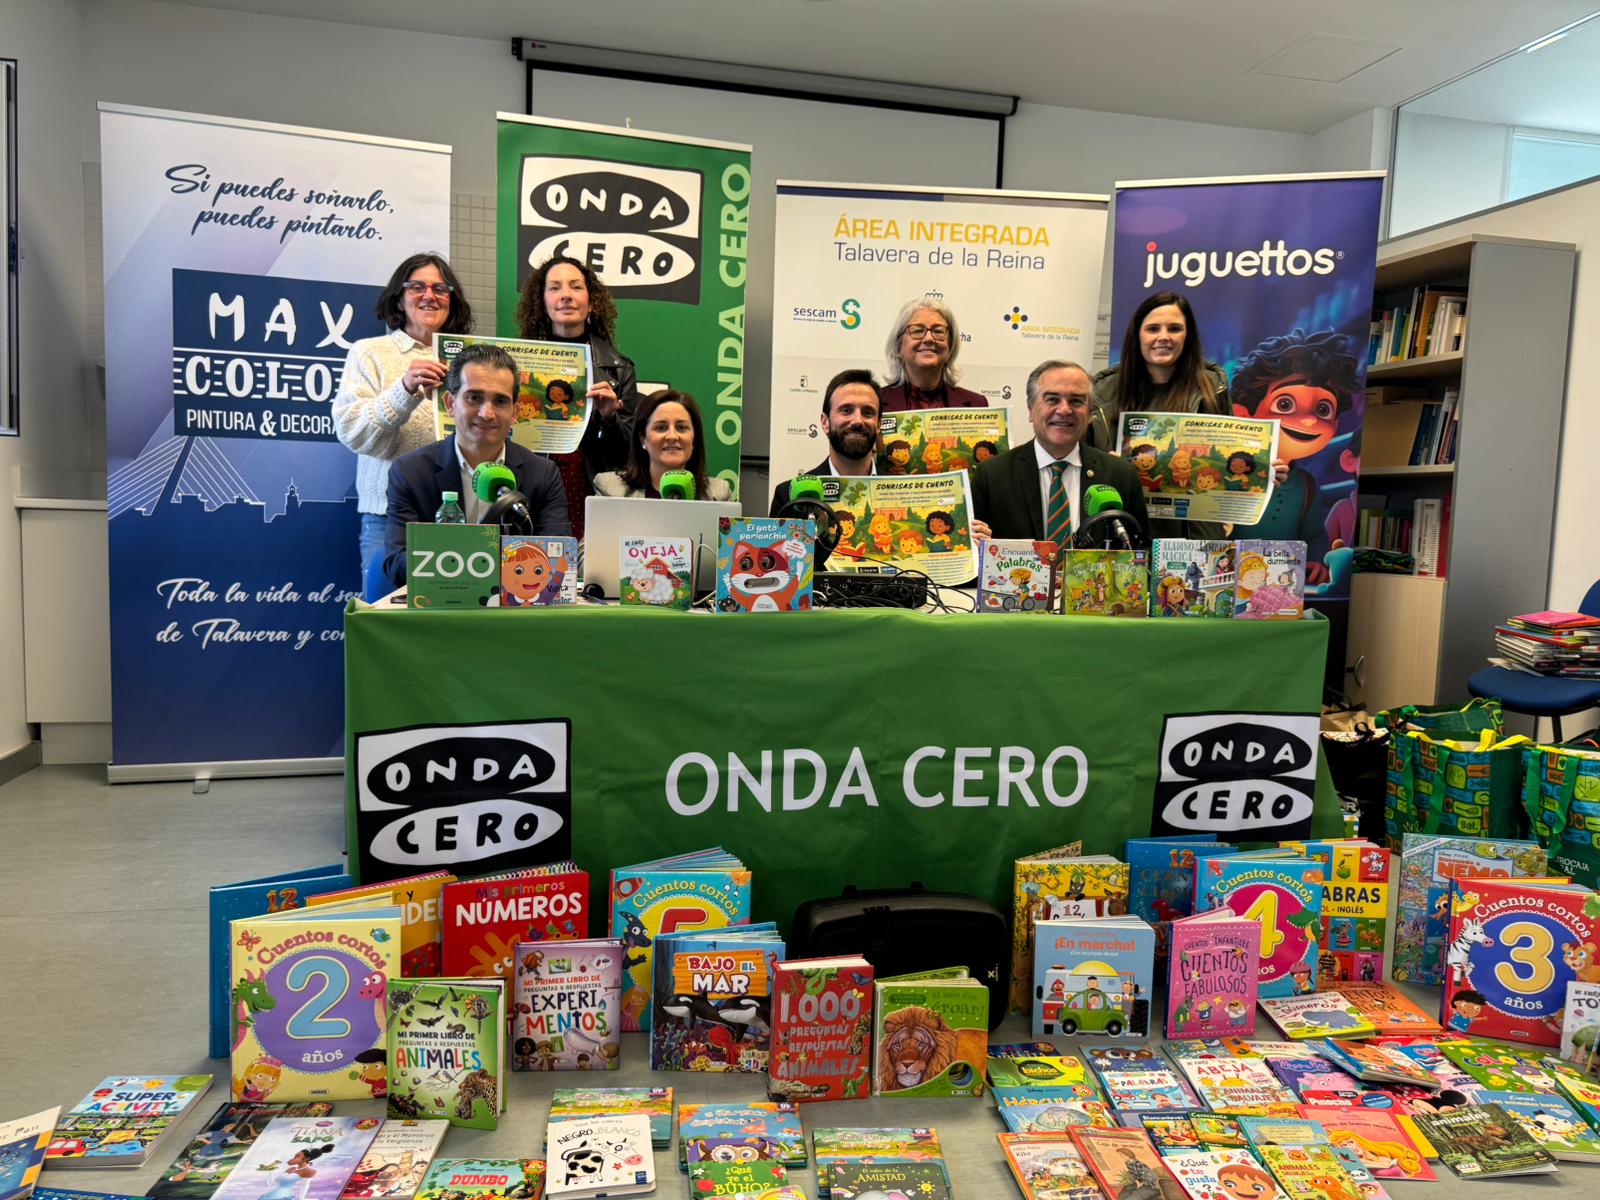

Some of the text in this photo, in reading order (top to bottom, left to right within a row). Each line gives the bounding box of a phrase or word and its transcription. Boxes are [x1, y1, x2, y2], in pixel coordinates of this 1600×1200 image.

[165, 164, 395, 214] Si puedes soñarlo,
[546, 183, 675, 221] ONDA
[190, 205, 383, 244] puedes pintarlo.
[719, 163, 751, 288] CERO
[833, 213, 1050, 247] ÁREA INTEGRADA
[553, 239, 674, 276] CERO
[833, 241, 1045, 270] Talavera de la Reina
[208, 291, 354, 350] MAX
[793, 305, 837, 319] sescam
[539, 348, 579, 358] DE CUENTO
[184, 355, 334, 403] COLO
[715, 304, 745, 446] ONDA
[186, 409, 256, 431] PINTURA
[259, 410, 277, 436] &
[929, 414, 964, 422] SONRISAS
[1183, 420, 1222, 428] SONRISAS
[1235, 424, 1264, 433] CUENTO
[875, 483, 914, 491] SONRISAS
[926, 480, 954, 488] CUENTO
[746, 523, 778, 533] El gato
[628, 544, 678, 560] OVEJA
[1001, 547, 1033, 556] Encuent
[1262, 547, 1290, 557] La bella
[411, 550, 495, 579] ZOO
[995, 556, 1044, 573] Palabras
[1266, 557, 1301, 566] durmiente
[157, 577, 331, 609] Toda la vida al
[156, 618, 313, 651] de Talavera y
[1182, 740, 1295, 768] ONDA
[384, 752, 539, 792] ONDA
[664, 745, 1089, 817] ONDA CERO
[1183, 788, 1294, 821] CERO
[396, 811, 540, 855] CERO
[1169, 849, 1194, 869] 12
[1437, 862, 1510, 878] NEMO
[476, 881, 566, 899] Mis primeros
[1215, 869, 1313, 903] Cuentos cortos
[266, 887, 298, 913] 12
[632, 880, 740, 916] Cuentos cortos
[1322, 886, 1381, 904] ABRAS
[455, 890, 583, 928] NÚMEROS
[1474, 895, 1592, 938] Cuentos cortos
[1243, 889, 1285, 959] 4
[256, 929, 388, 970] Cuentos cortos
[1055, 938, 1076, 950] ¡En
[1082, 939, 1137, 951] marcha!
[1213, 935, 1250, 949] INFANTILES
[688, 956, 756, 972] BAJO EL
[1180, 949, 1248, 981] CUENTOS
[1493, 921, 1556, 995] 3
[523, 974, 601, 987] MI PRIMER LIBRO DE
[565, 983, 602, 991] RESPUESTAS
[692, 973, 750, 995] MAR
[1183, 974, 1247, 998] FABULOSOS
[285, 955, 352, 1040] 2
[531, 989, 598, 1013] EXPERI
[1503, 996, 1544, 1010] años
[1573, 998, 1600, 1009] TO
[780, 989, 861, 1024] 1.000
[525, 1011, 608, 1036] MENTOS
[789, 1024, 849, 1037] PREGUNTAS
[409, 1031, 439, 1039] PRIMER
[440, 1032, 464, 1040] LIBRO
[789, 1039, 849, 1053] RESPUESTAS
[302, 1049, 344, 1064] años
[396, 1047, 482, 1071] ANIMALES
[777, 1057, 860, 1078] ANIMALES
[1196, 1062, 1254, 1076] ABEJA
[112, 1091, 177, 1102] SUPER
[1223, 1087, 1277, 1095] ANIMALES
[86, 1101, 176, 1112] ACTIVITY
[1307, 1097, 1353, 1106] Pinocho
[1431, 1110, 1490, 1127] animales
[290, 1126, 345, 1137] TIANA
[290, 1136, 334, 1144] SAPO
[557, 1128, 594, 1145] NEGRO
[725, 1166, 753, 1175] ¿Qué
[1278, 1163, 1321, 1171] ANIMALES
[449, 1173, 509, 1186] DUMBO
[743, 1174, 754, 1182] el
[853, 1173, 907, 1184] AMISTAD
[1185, 1174, 1217, 1186] gusta
[714, 1181, 771, 1196] BÚHO?
